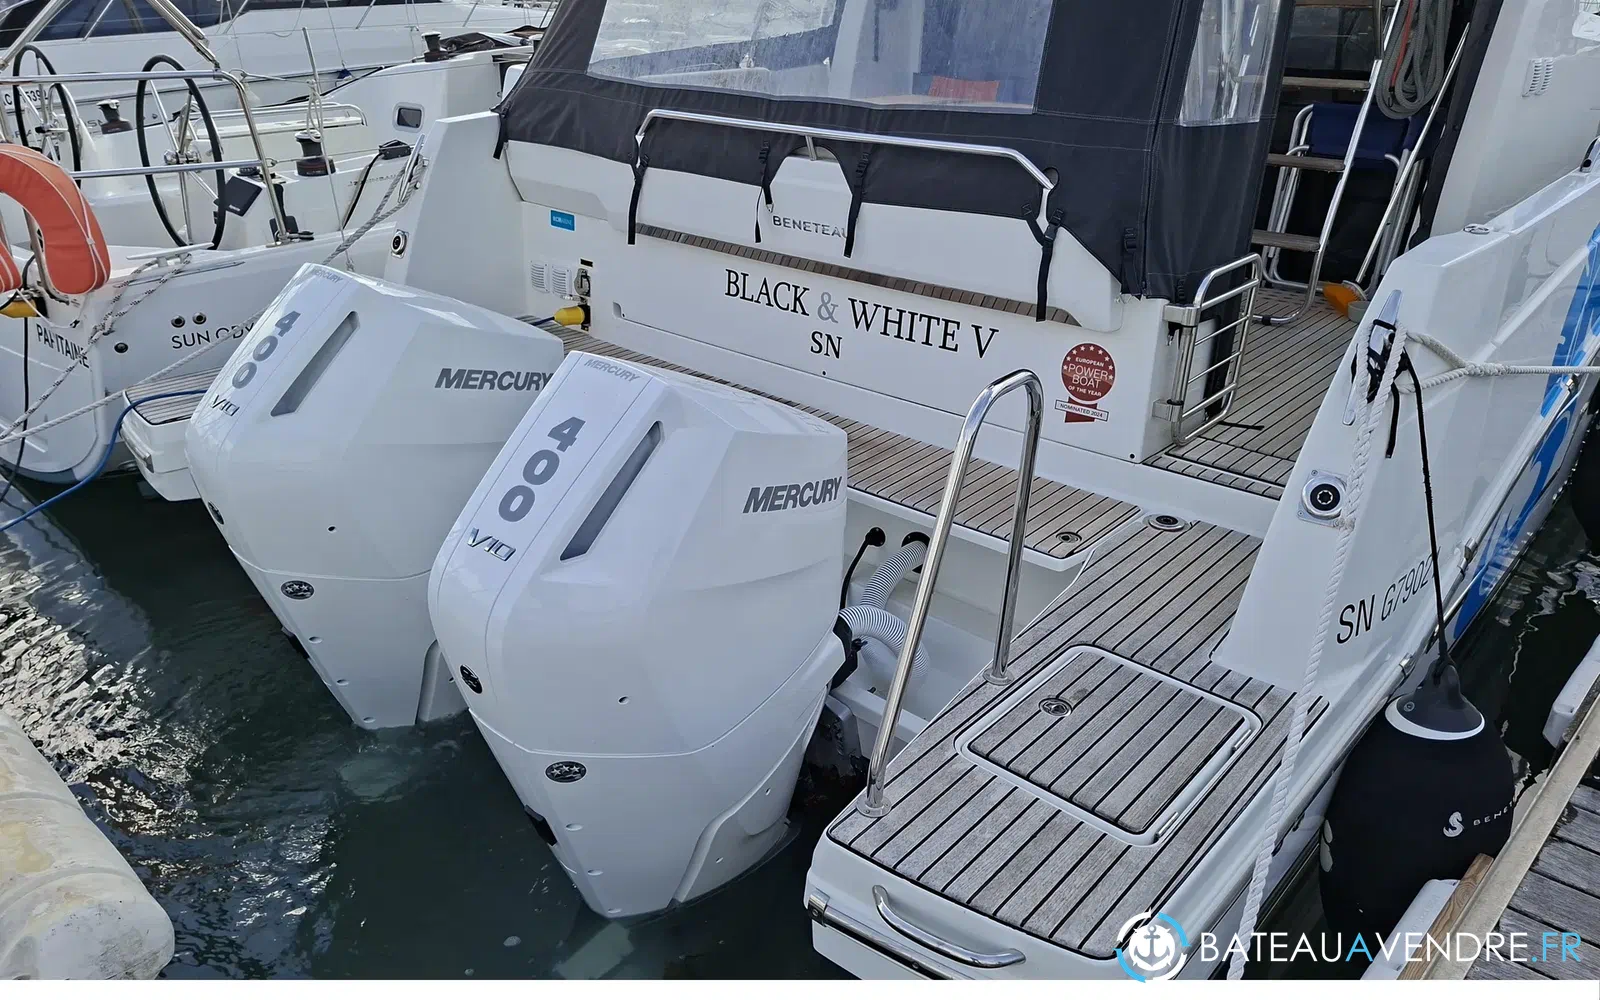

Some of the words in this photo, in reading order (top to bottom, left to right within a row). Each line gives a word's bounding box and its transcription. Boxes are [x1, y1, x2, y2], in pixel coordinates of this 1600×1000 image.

[725, 268, 810, 317] BLACK
[816, 291, 839, 324] &
[848, 297, 961, 353] WHITE
[971, 324, 999, 359] V
[171, 330, 211, 350] SUN
[232, 310, 301, 389] 400
[810, 330, 843, 359] SN
[584, 358, 641, 383] MERCURY
[1068, 363, 1108, 381] POWER
[1075, 357, 1104, 367] EUROPEAN
[1072, 374, 1101, 389] BOAT
[1076, 386, 1087, 394] THE
[1087, 389, 1102, 397] YEAR
[1060, 403, 1090, 415] NOMINATED
[1091, 410, 1103, 418] 2024
[498, 416, 586, 523] 400
[742, 476, 842, 514] MERCURY
[467, 528, 517, 562] V10
[1336, 594, 1375, 644] SN
